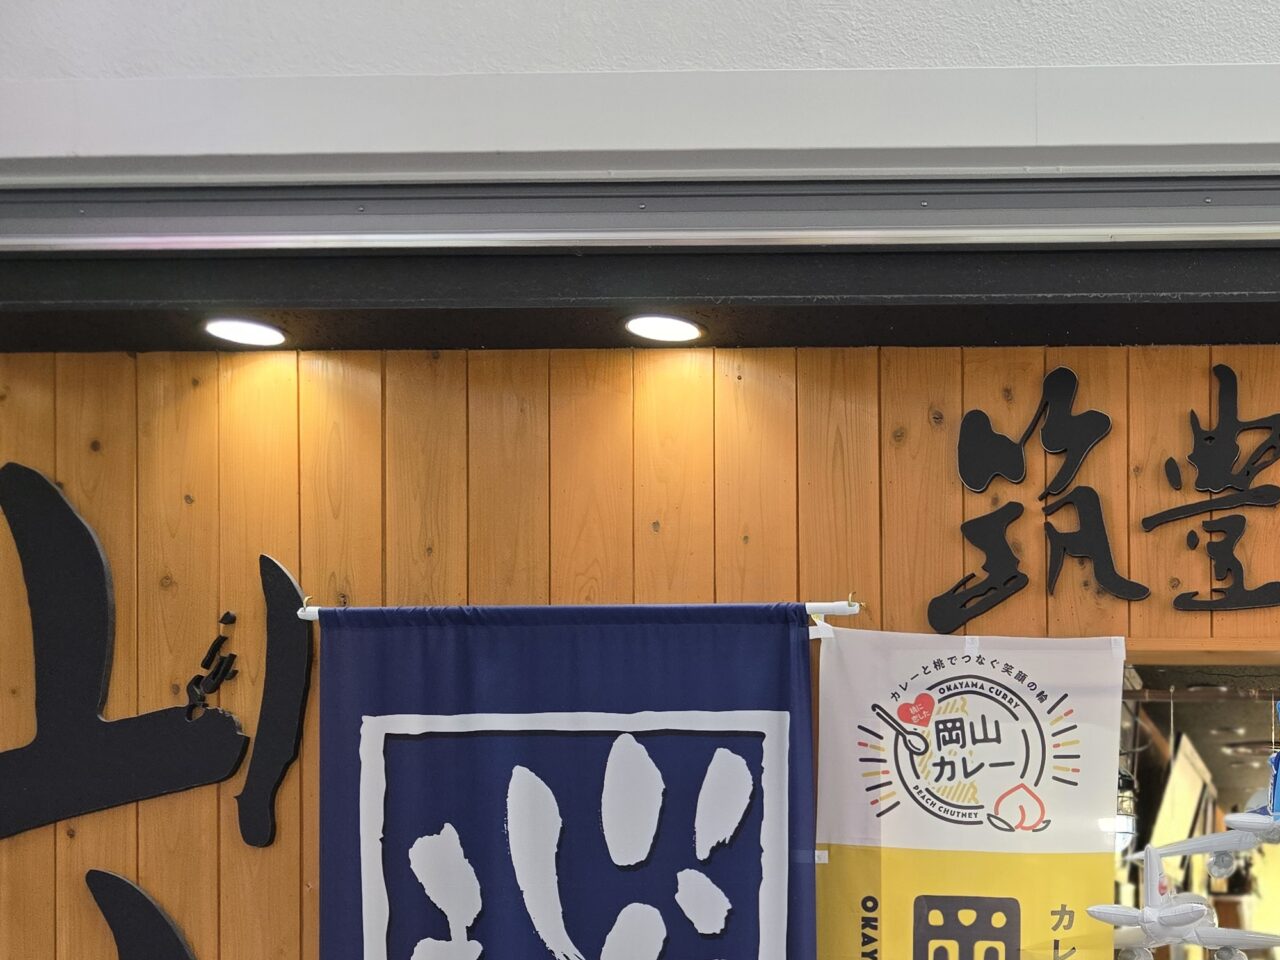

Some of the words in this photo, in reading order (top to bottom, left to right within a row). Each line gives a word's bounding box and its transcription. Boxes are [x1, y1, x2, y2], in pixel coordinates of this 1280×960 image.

[890, 654, 1048, 704] カレーと桃でつなぐ笑顔の輪
[938, 681, 985, 695] OKAYAMA
[988, 686, 1021, 709] CURRY
[934, 714, 1001, 751] 岡山
[932, 756, 1015, 783] カレー
[912, 784, 937, 809] PEACH
[938, 805, 979, 819] CHUTNEY
